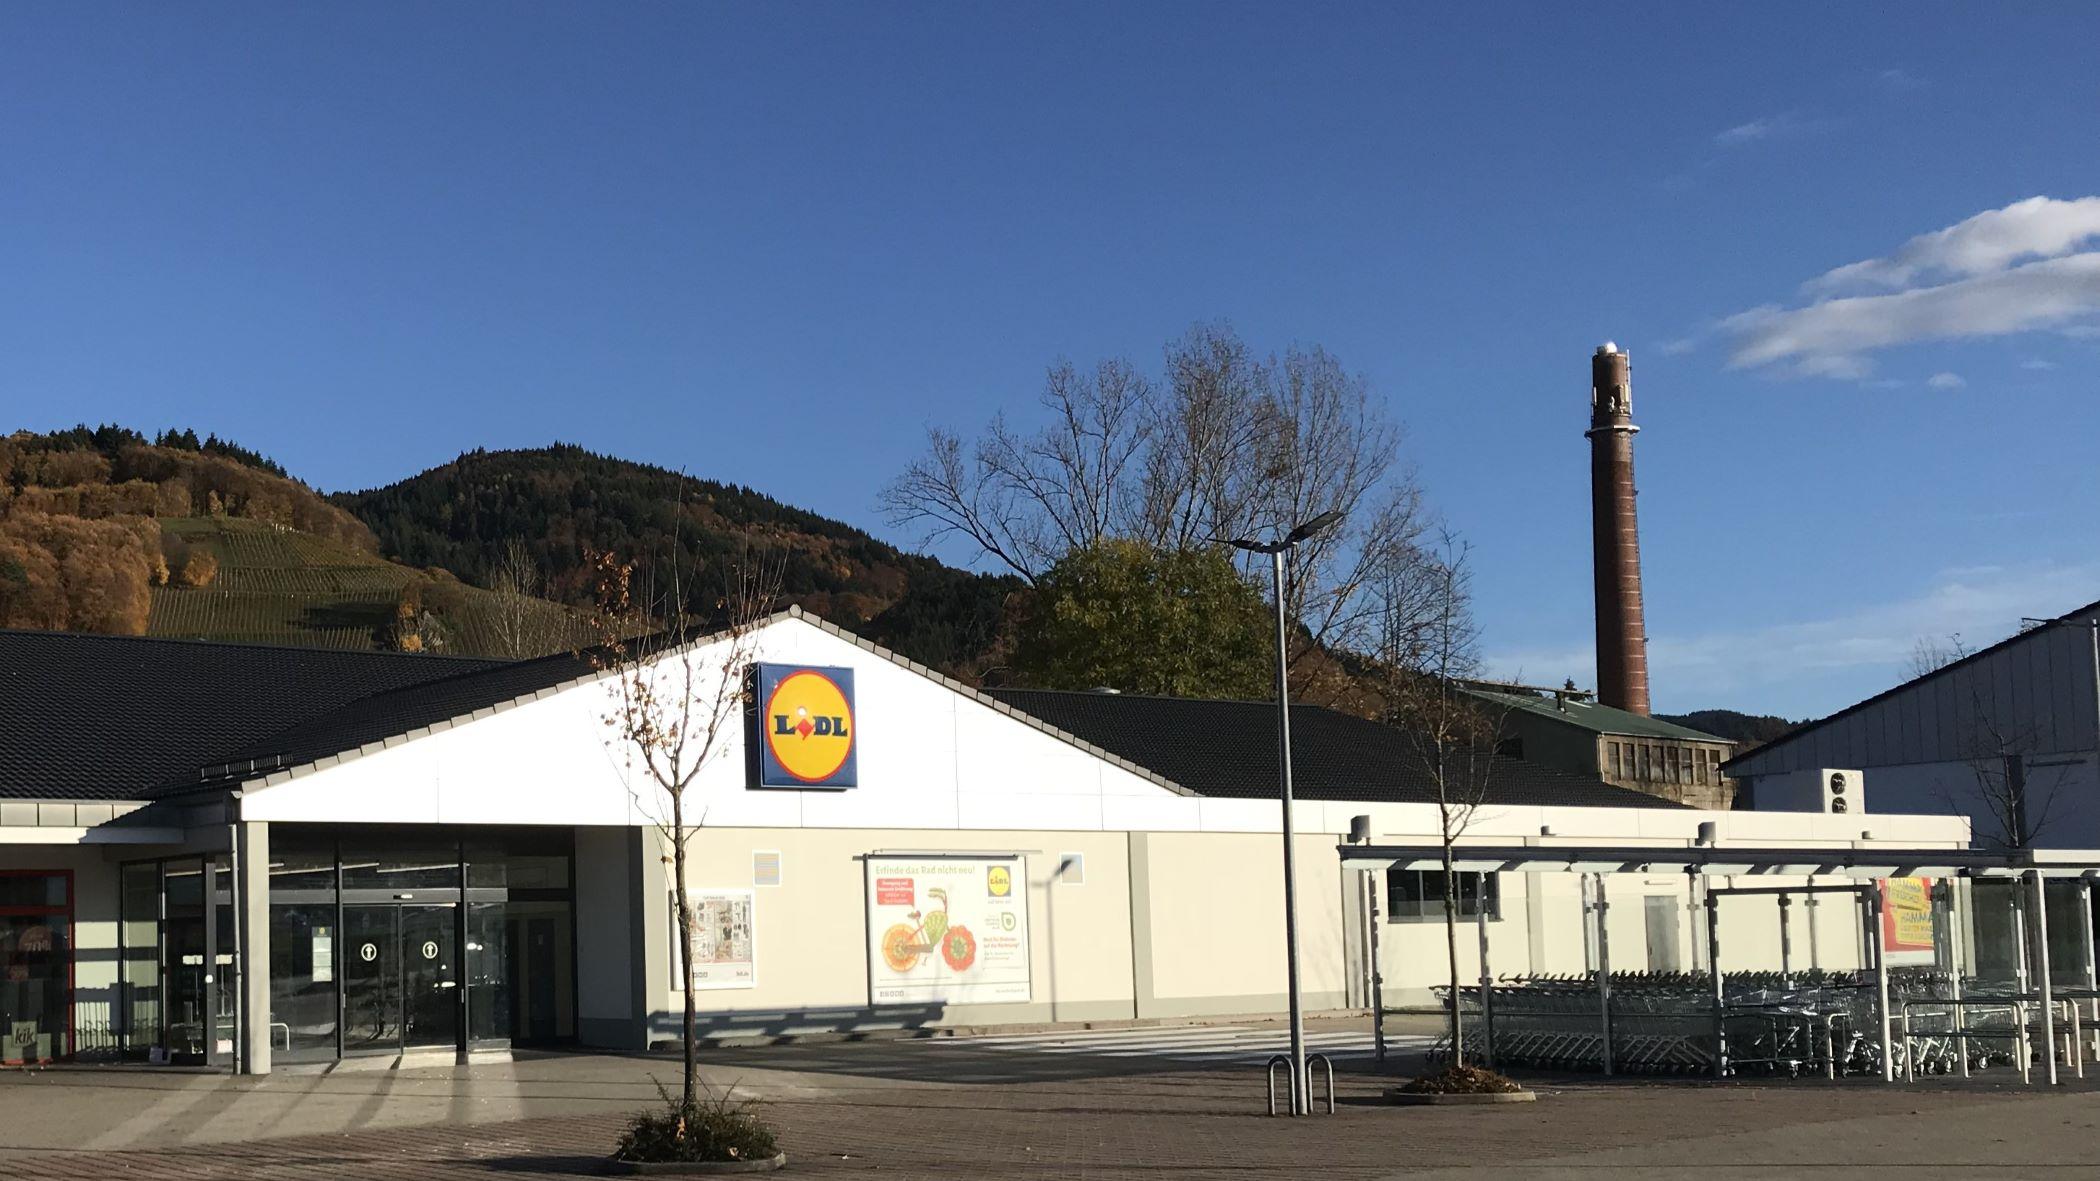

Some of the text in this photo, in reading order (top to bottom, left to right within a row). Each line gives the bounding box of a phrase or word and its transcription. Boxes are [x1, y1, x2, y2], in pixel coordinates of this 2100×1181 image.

[875, 865, 975, 875] Erfinde das Rad nicht neu!
